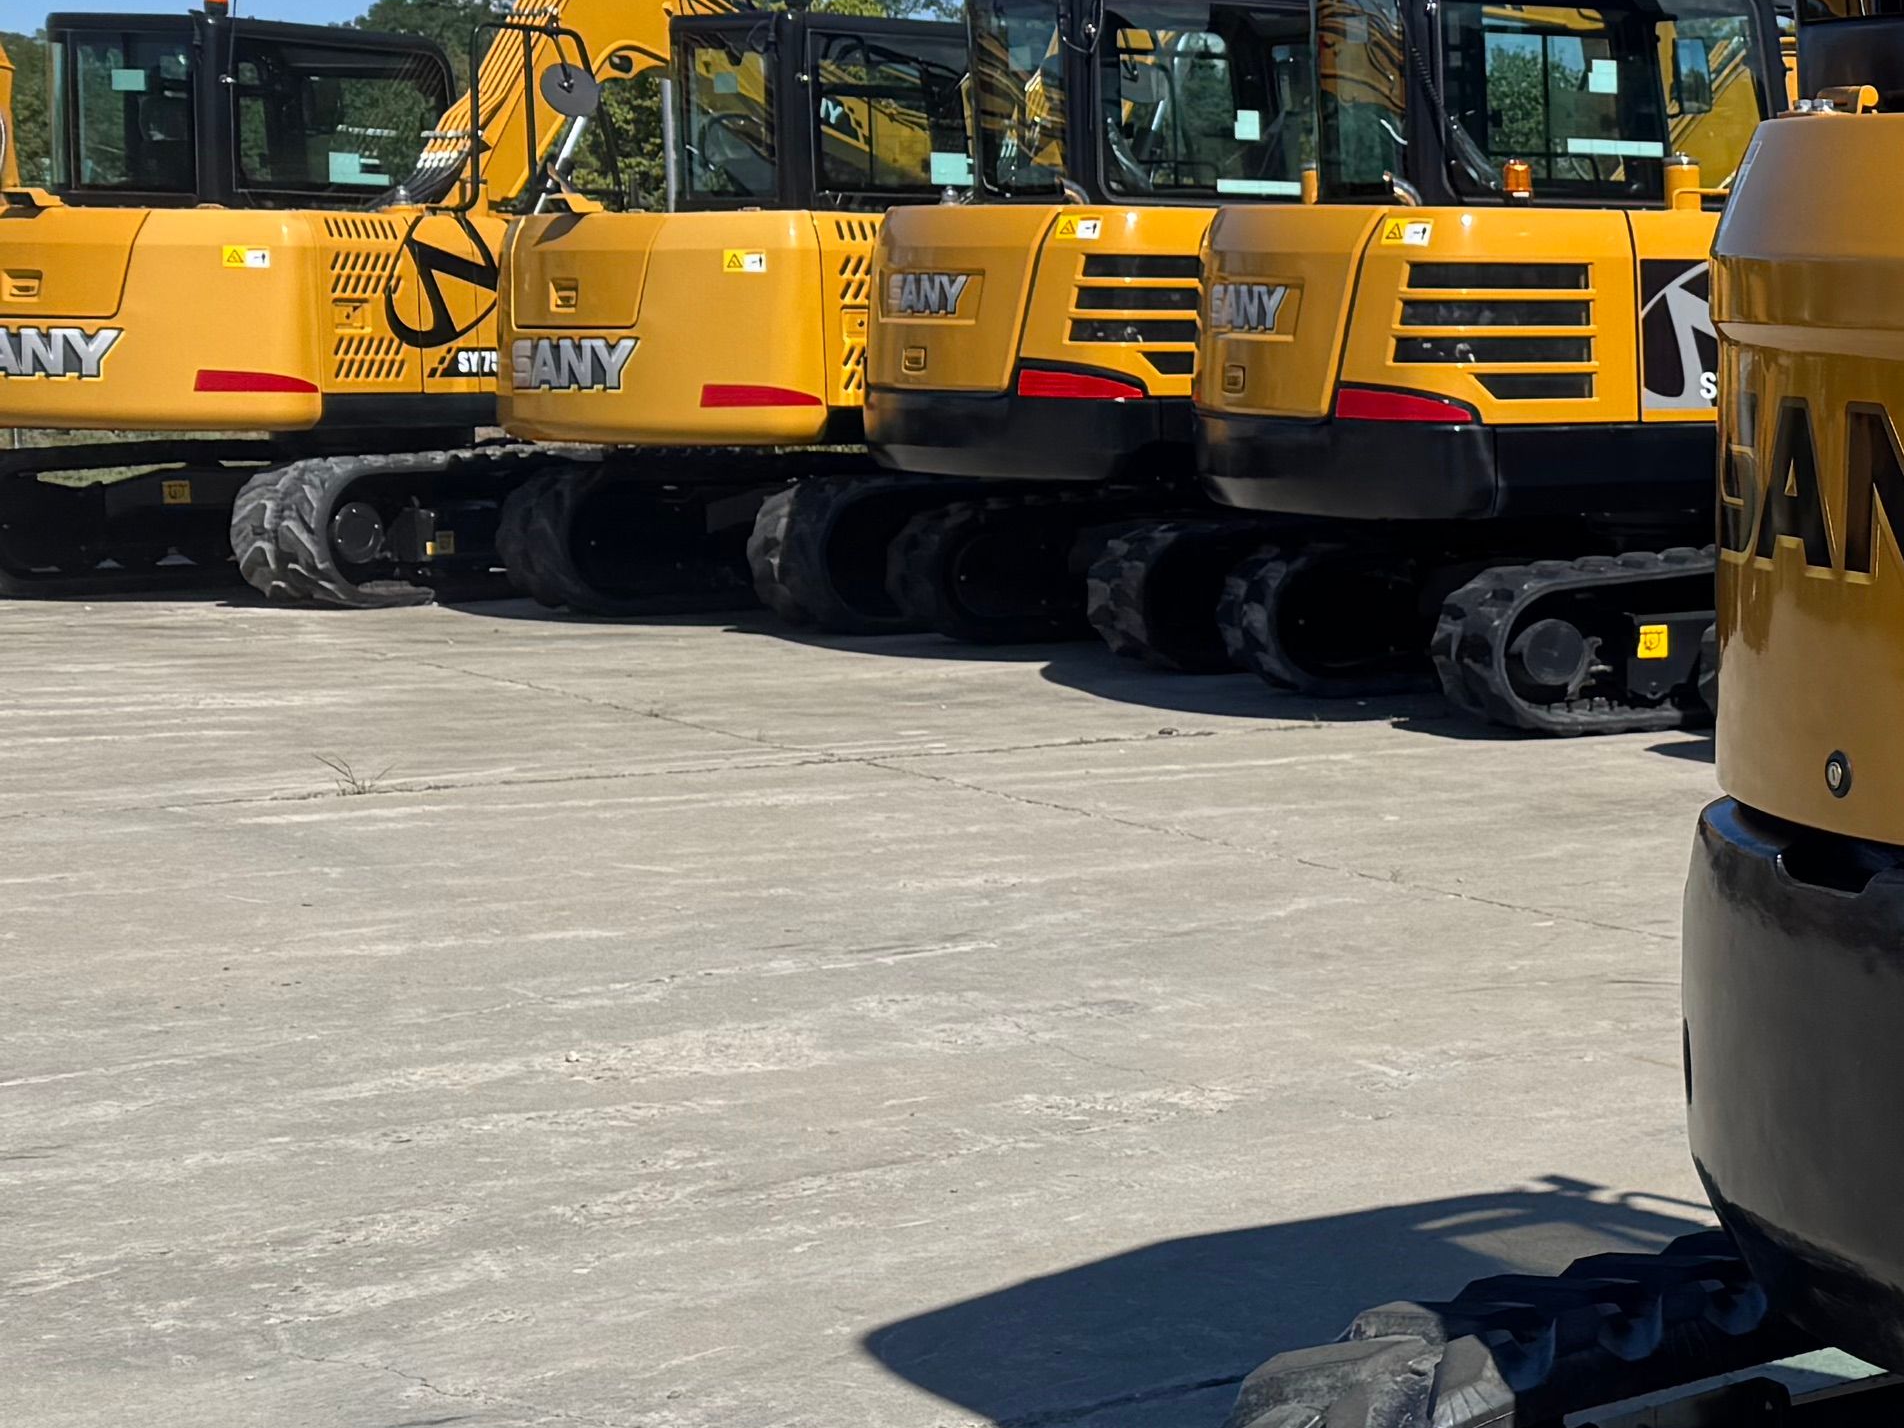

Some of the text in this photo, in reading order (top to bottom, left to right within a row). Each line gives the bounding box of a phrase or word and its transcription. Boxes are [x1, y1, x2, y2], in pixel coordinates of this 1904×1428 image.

[888, 273, 968, 313] SANY
[1212, 282, 1286, 329] SANY
[0, 326, 123, 377] ANY
[512, 337, 637, 389] SANY
